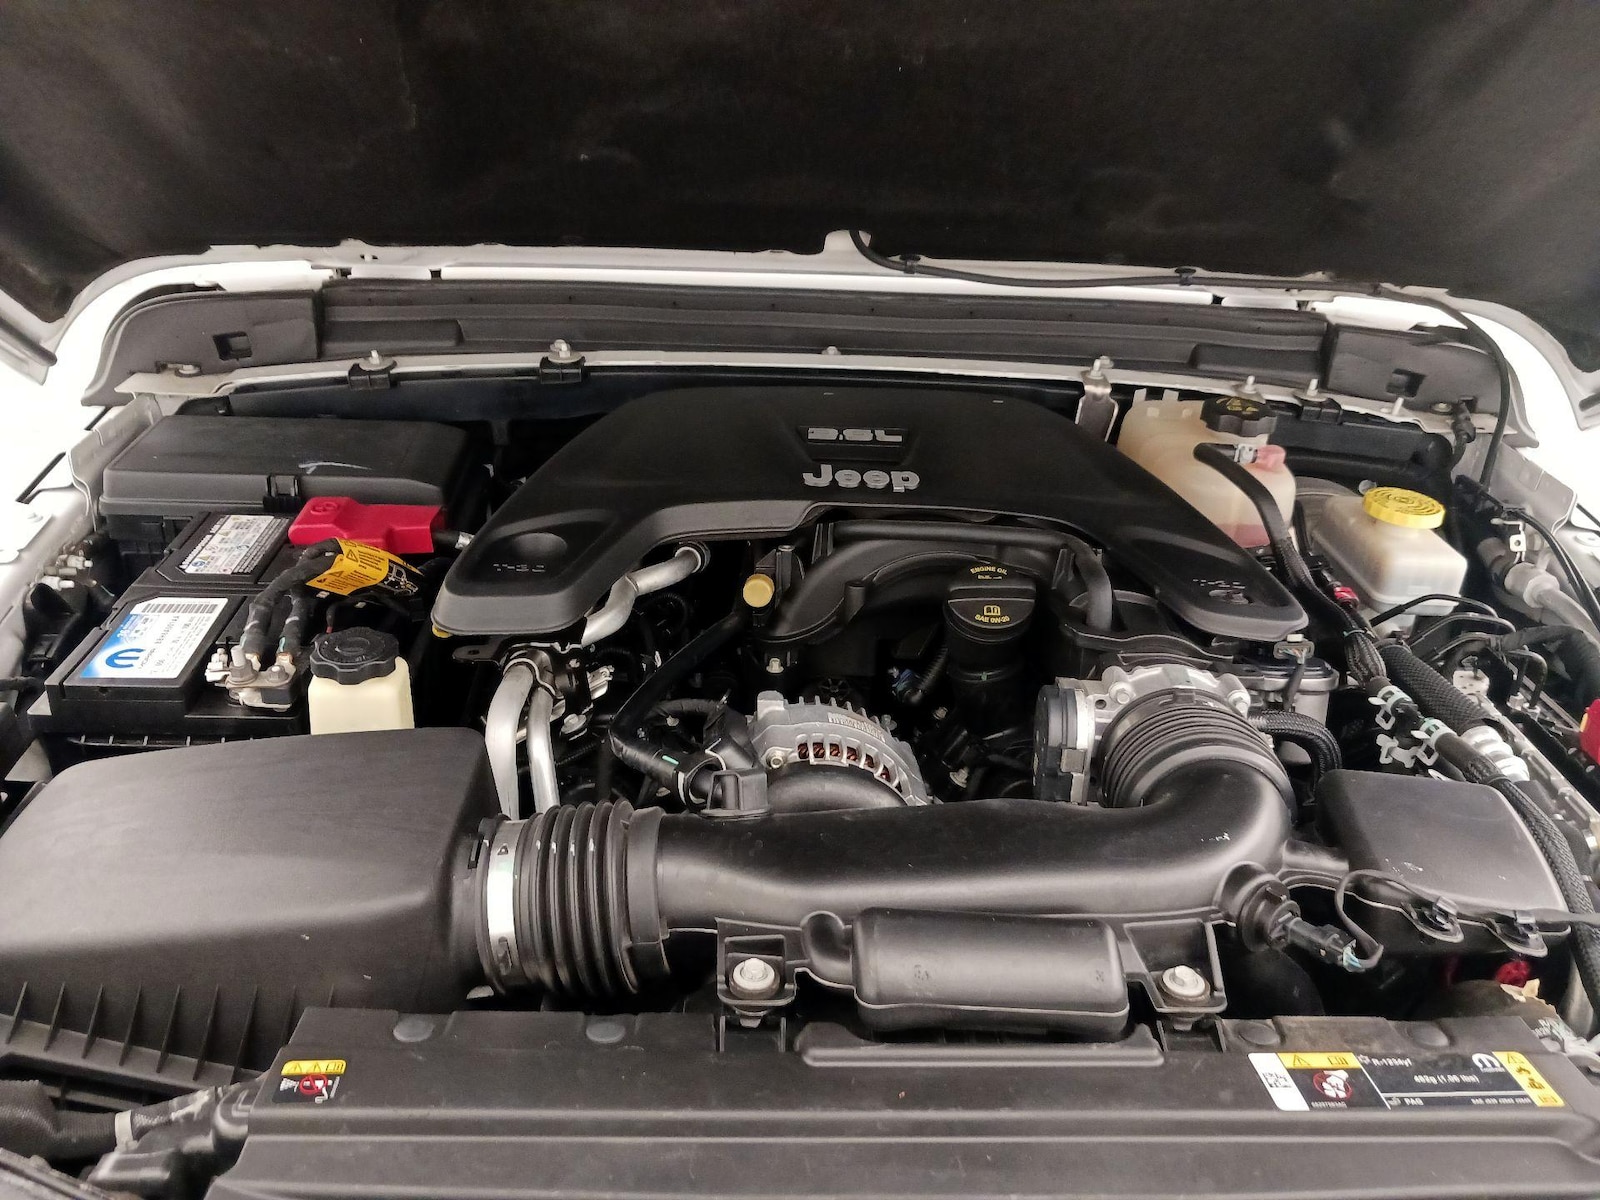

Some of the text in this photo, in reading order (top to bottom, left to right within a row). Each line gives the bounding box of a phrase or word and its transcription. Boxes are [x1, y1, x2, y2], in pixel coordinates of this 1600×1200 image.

[802, 464, 920, 493] Jeep
[970, 566, 1008, 575] ENGINE OIL
[974, 614, 1010, 623] SAE 0W-20
